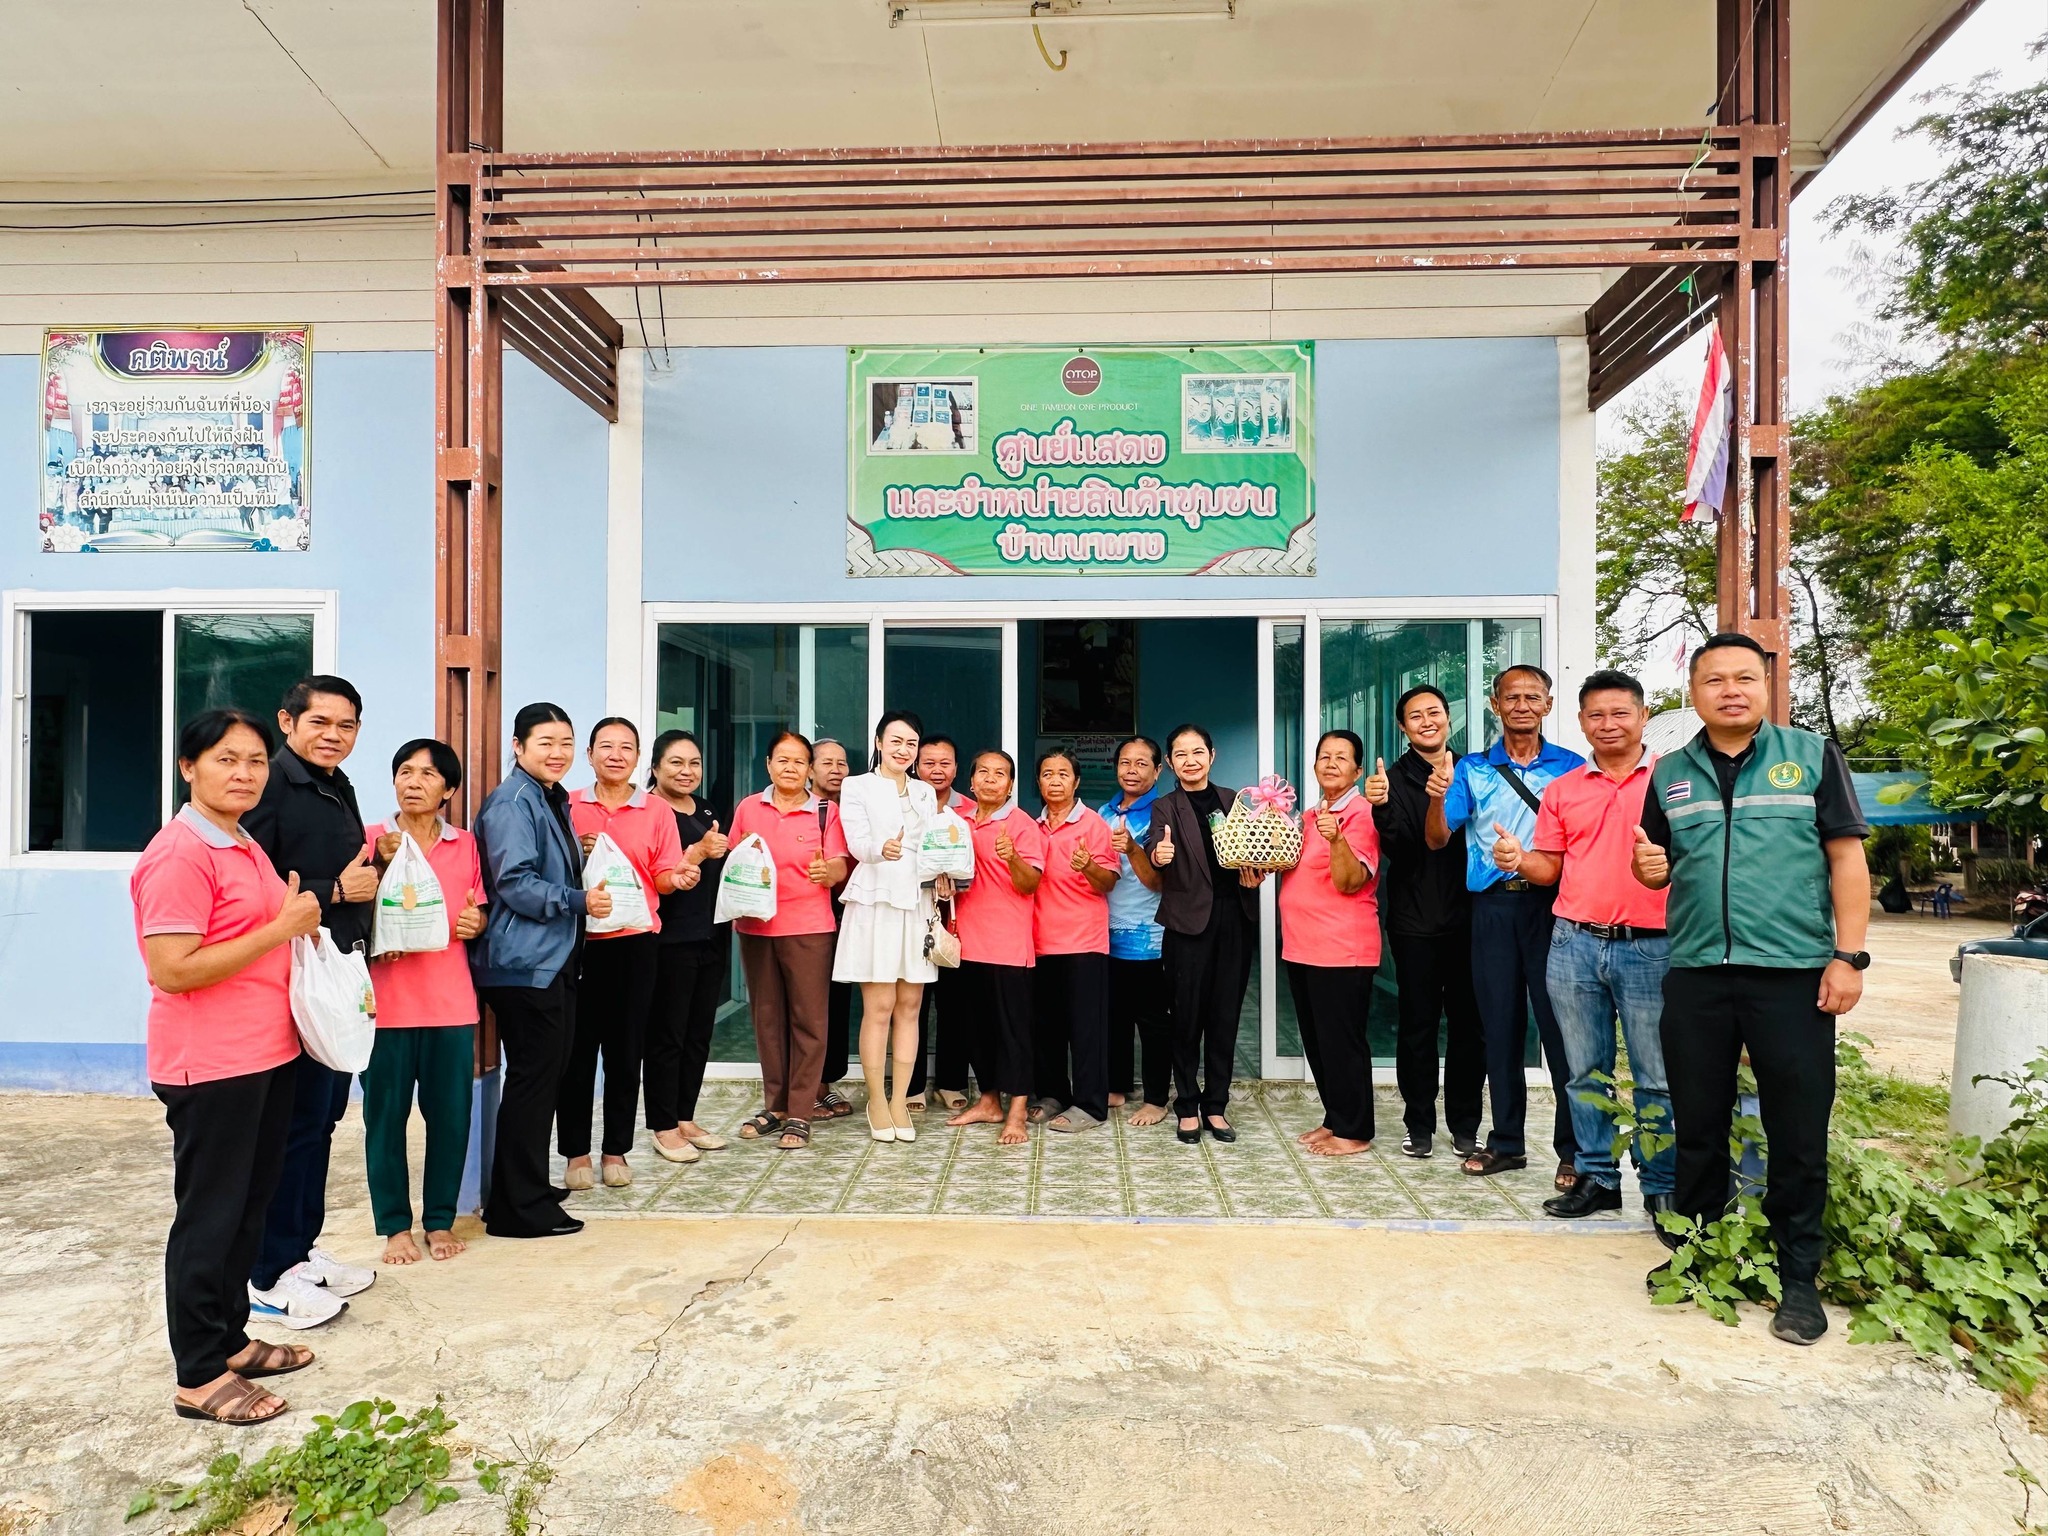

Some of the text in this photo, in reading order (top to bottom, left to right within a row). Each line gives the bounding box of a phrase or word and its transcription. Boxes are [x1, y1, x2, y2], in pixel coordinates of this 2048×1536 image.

[130, 338, 229, 370] คติพจน์
[1065, 369, 1098, 379] OTOP
[86, 392, 271, 416] เราจะอยู่ร่วมกันฉันท์พี่น้อง
[1020, 403, 1138, 411] ONE TAMBON ONE PRODUCT
[92, 426, 264, 443] จะประคองกันไปให้ถึงฝัน
[997, 421, 1165, 475] ศูนย์แสดง
[80, 487, 277, 511] สำนึกมั่นมุ่งเน้นความเป็นทีม
[886, 477, 1275, 527] และจำหน่ายสินค้าชุมชน
[997, 525, 1164, 558] บ้านนาผาง
